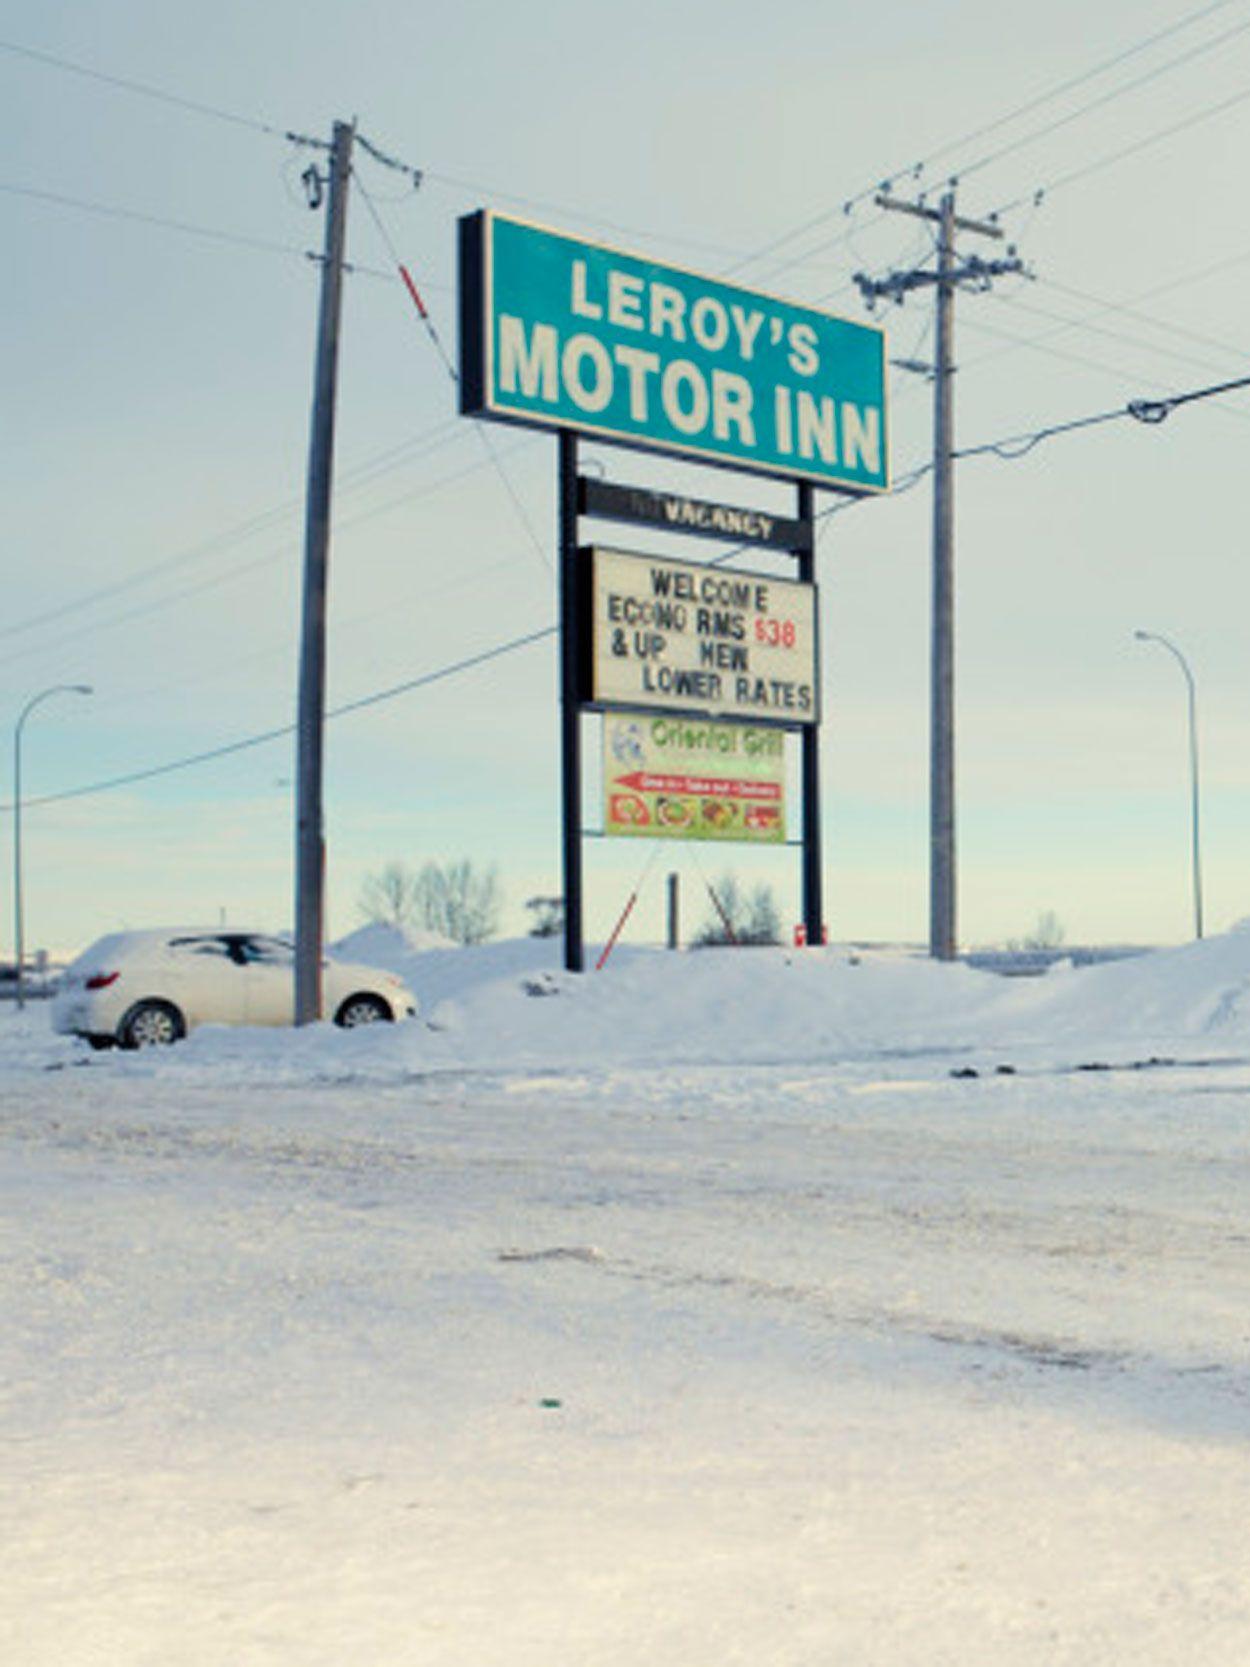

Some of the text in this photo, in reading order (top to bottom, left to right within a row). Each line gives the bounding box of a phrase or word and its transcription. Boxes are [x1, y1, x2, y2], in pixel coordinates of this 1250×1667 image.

[571, 259, 820, 378] LEROY'S
[499, 313, 881, 475] MOTOR INN
[664, 496, 774, 540] VACANCY
[650, 567, 769, 613] WELCOME
[607, 593, 797, 649] ECONO RMS $38
[611, 627, 749, 672] & UP NEW
[643, 665, 812, 713] LOWER RATES
